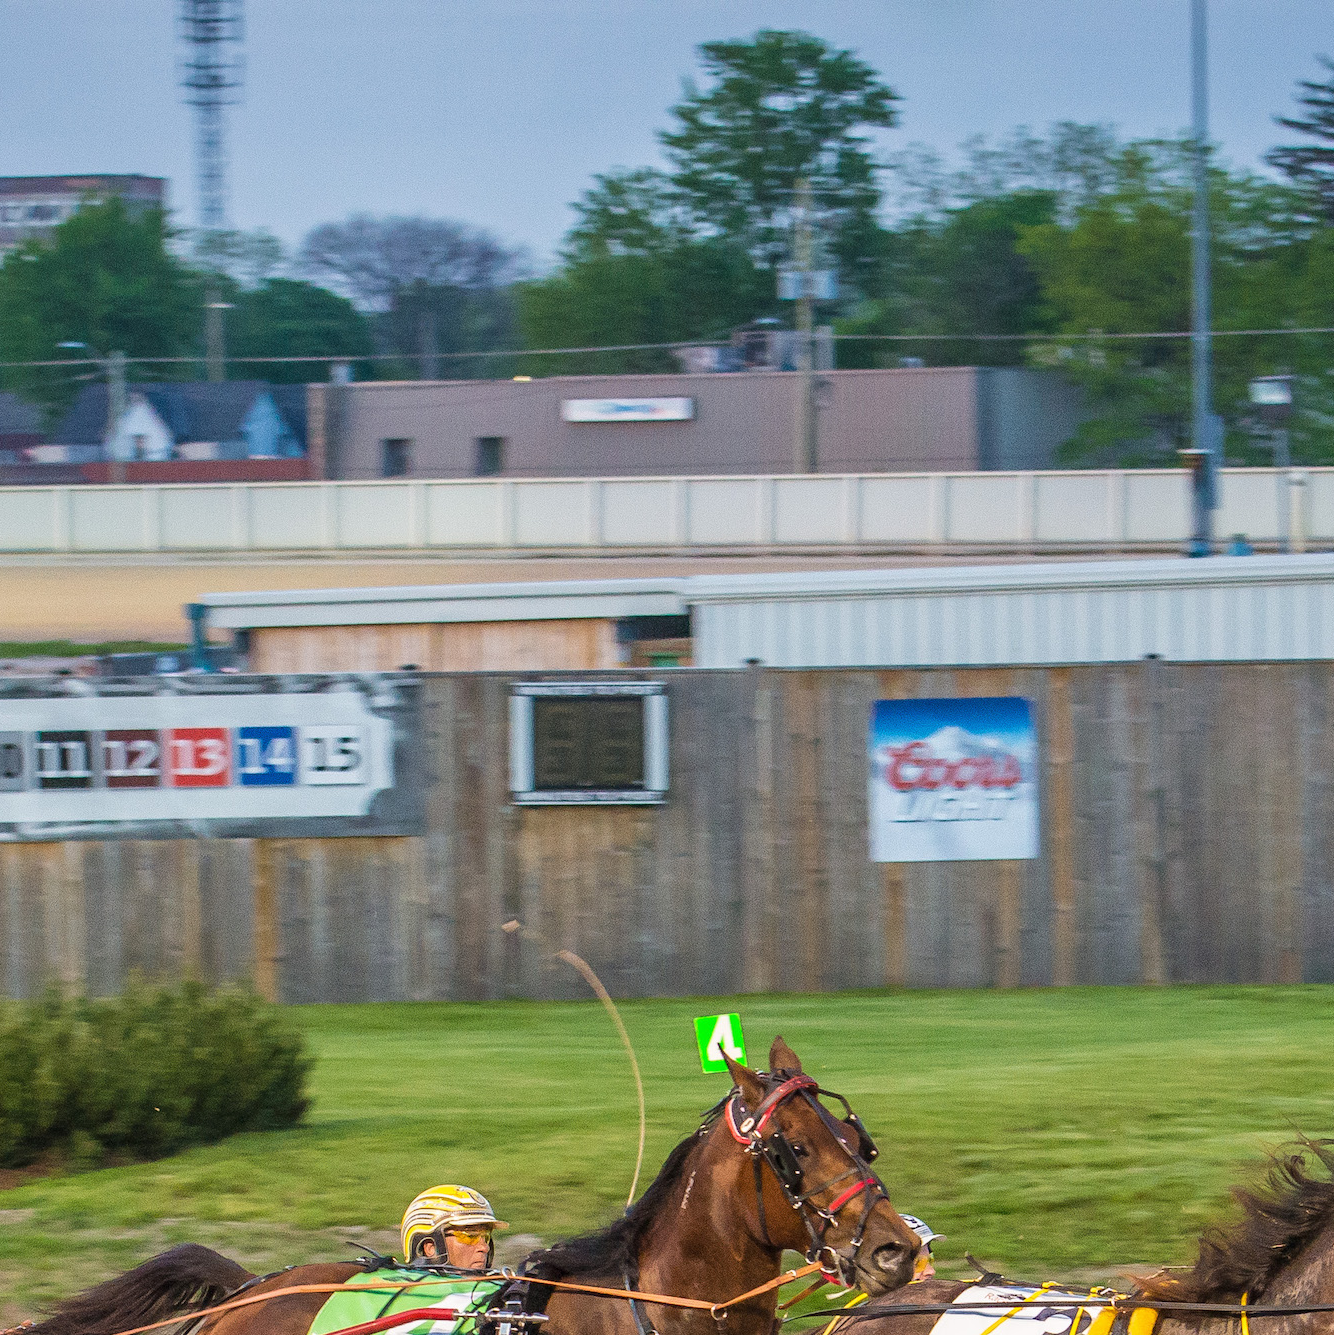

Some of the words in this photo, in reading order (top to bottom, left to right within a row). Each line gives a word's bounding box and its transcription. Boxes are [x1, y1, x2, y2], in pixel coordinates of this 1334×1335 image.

[35, 742, 90, 779] 11
[101, 741, 158, 777] 12
[170, 739, 227, 776] 13
[237, 738, 293, 774] 14
[307, 736, 362, 772] 15
[706, 1013, 744, 1062] 4
